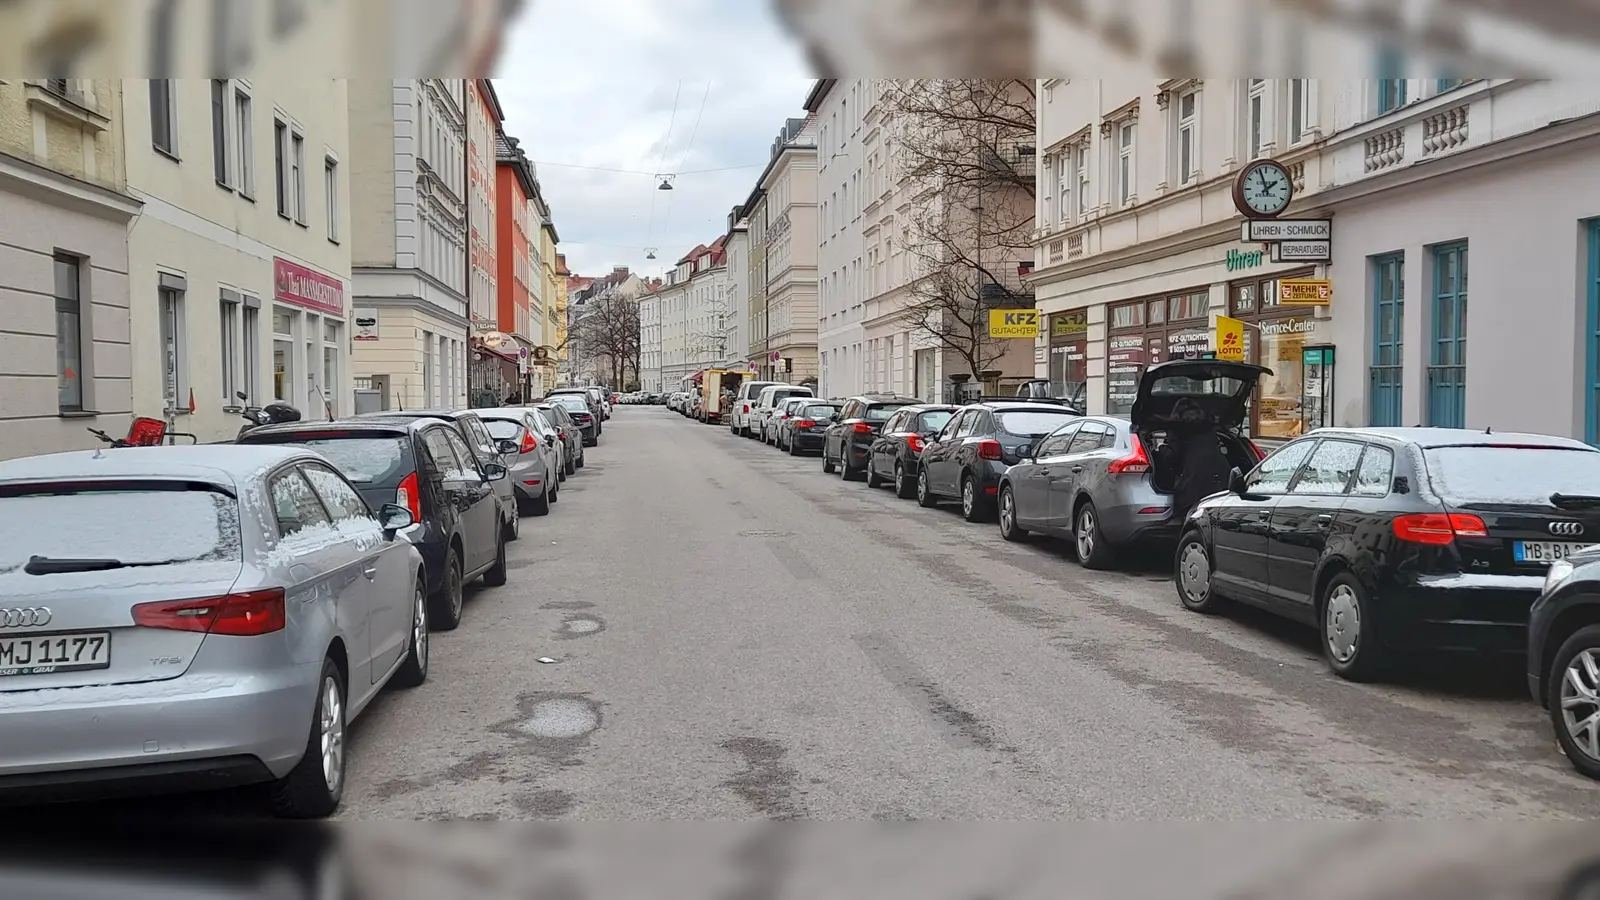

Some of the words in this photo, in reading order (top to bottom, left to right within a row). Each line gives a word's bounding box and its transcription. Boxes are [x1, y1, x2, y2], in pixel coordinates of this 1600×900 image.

[1253, 226, 1280, 236] UHREN
[1287, 225, 1328, 235] SCHMUCK
[1282, 245, 1327, 254] REPARATUREN
[1226, 248, 1263, 272] Uhren
[287, 271, 300, 297] Thai
[1292, 285, 1317, 293] MEHR
[1004, 313, 1036, 325] KFZ
[991, 327, 1037, 335] GUTACHTER
[1261, 319, 1315, 335] Service-Center
[1524, 543, 1542, 559] MB
[1553, 544, 1571, 559] BA
[1471, 559, 1490, 567] A3
[150, 656, 182, 665] TFSI
[32, 666, 56, 674] GRAF
